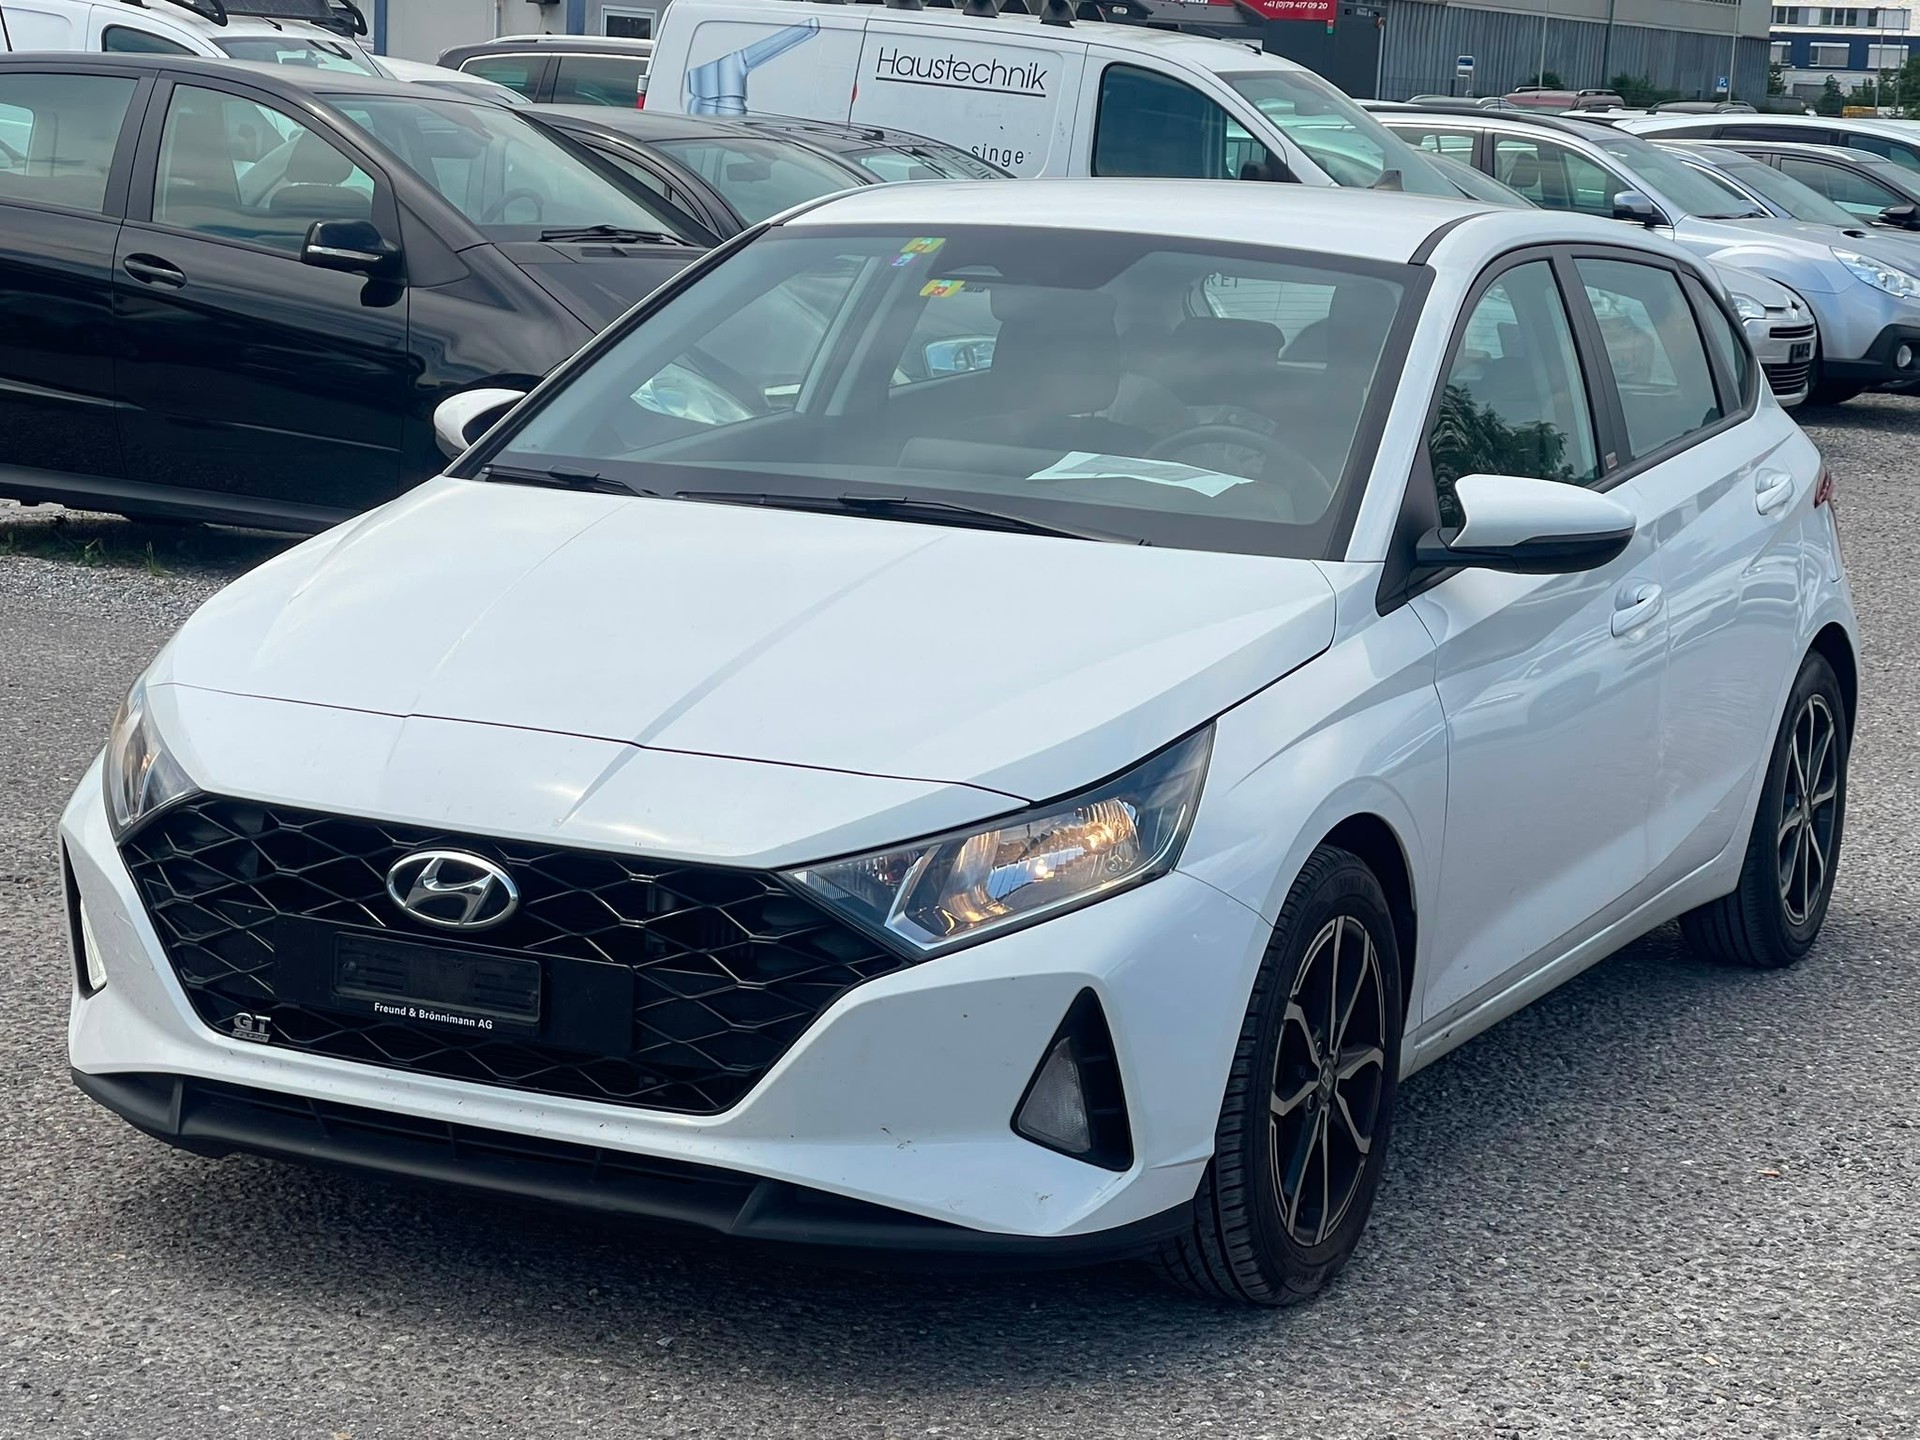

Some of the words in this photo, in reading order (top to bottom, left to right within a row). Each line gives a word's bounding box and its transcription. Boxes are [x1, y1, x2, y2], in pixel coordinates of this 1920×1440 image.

[877, 47, 1048, 90] Haustechnik
[233, 1012, 271, 1034] GT
[374, 1002, 406, 1016] Freund
[408, 1007, 416, 1018] &
[419, 1009, 475, 1027] Brönnimann
[478, 1019, 493, 1030] AG
